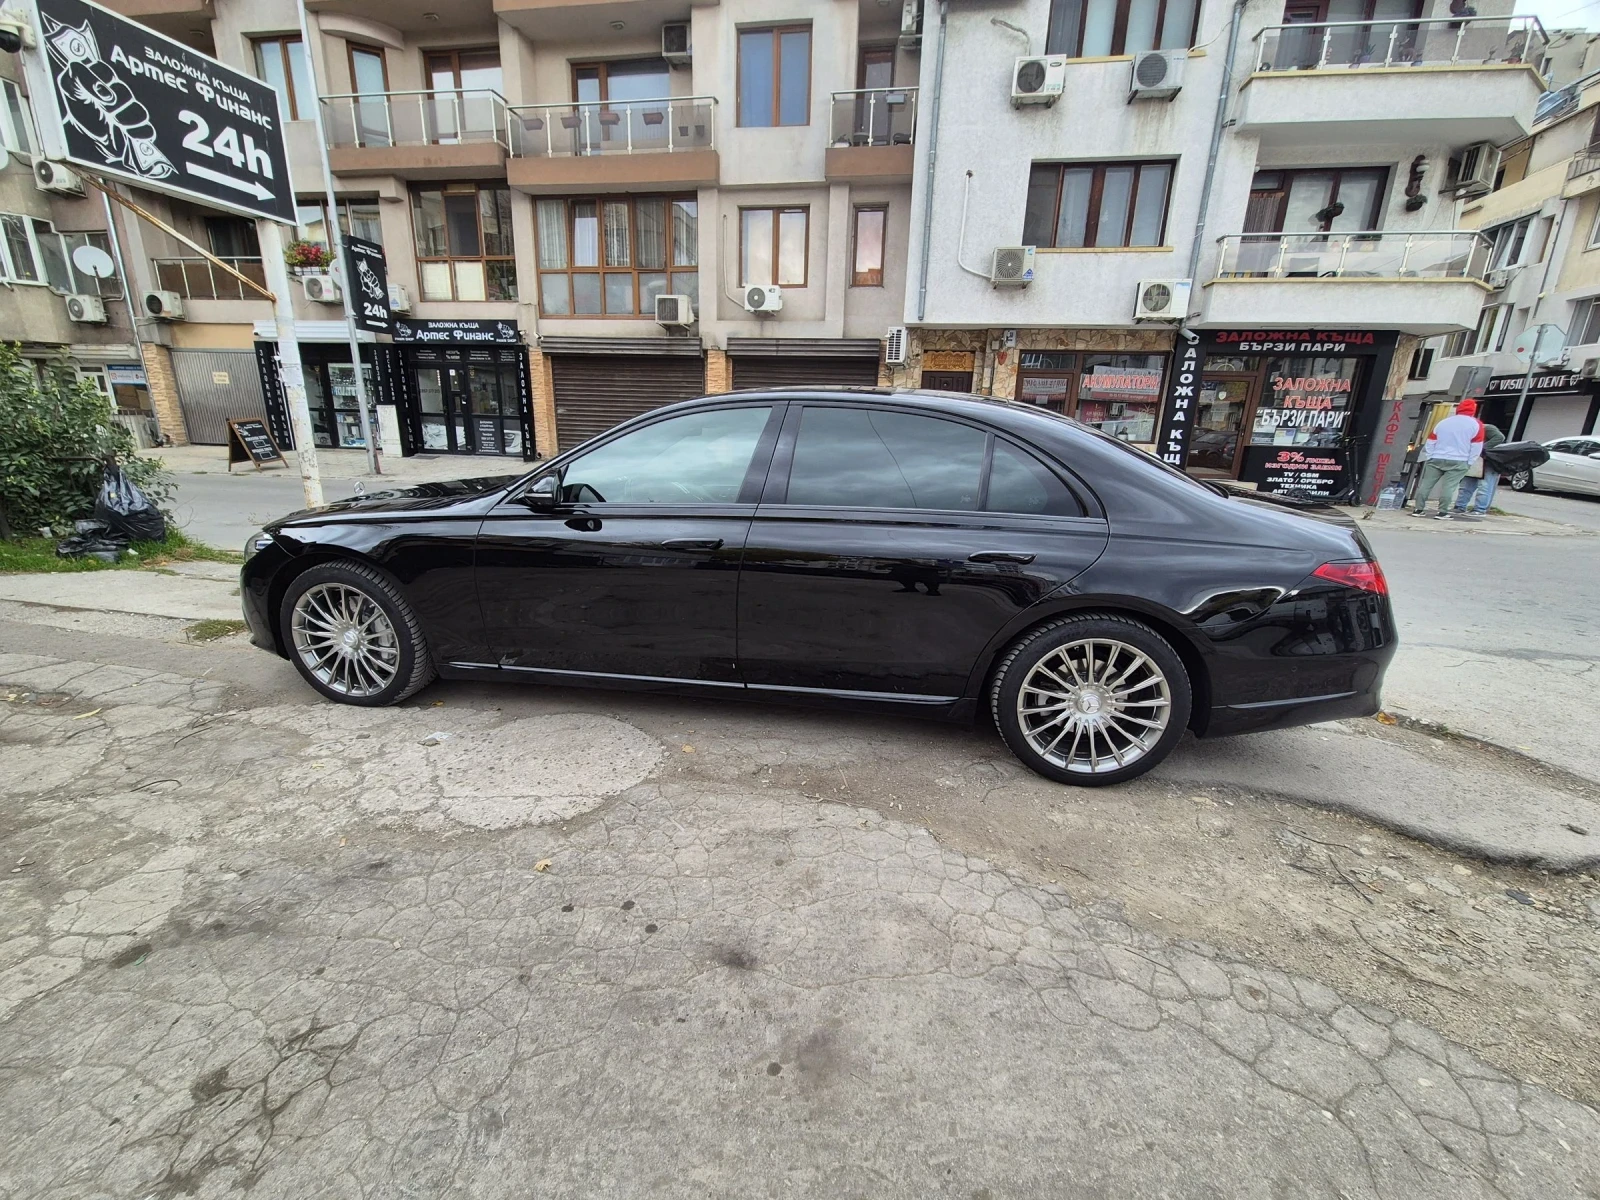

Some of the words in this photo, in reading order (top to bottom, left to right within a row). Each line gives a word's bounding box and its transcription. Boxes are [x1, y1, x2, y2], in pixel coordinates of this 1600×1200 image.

[144, 46, 210, 84] ЗАЛОЖНА
[212, 77, 250, 103] КЪЩА
[110, 45, 188, 94] Артес
[195, 82, 272, 130] Финанс
[178, 109, 273, 180] 24h
[363, 302, 388, 318] 24h
[416, 329, 450, 341] Артес
[453, 330, 494, 340] Финанс
[1216, 331, 1311, 343] ЗАЛОЖНА
[1316, 332, 1375, 345] КЪЩА
[1239, 342, 1295, 352] БЪРЗИ
[1300, 342, 1346, 352] ПАРИ
[519, 353, 528, 413] ЗАЛОЖНА
[1082, 373, 1158, 389] АКУМУЛАТОРИ
[1273, 377, 1351, 392] ЗАЛОЖНА
[1500, 377, 1537, 390] VASILV
[1537, 375, 1568, 389] DENT
[1283, 395, 1332, 411] КЪЩА
[1384, 401, 1404, 444] КАФЕ
[1163, 429, 1183, 465] КЪЩ
[1277, 451, 1304, 462] 3%
[1272, 488, 1330, 496] АВТИЛИ
